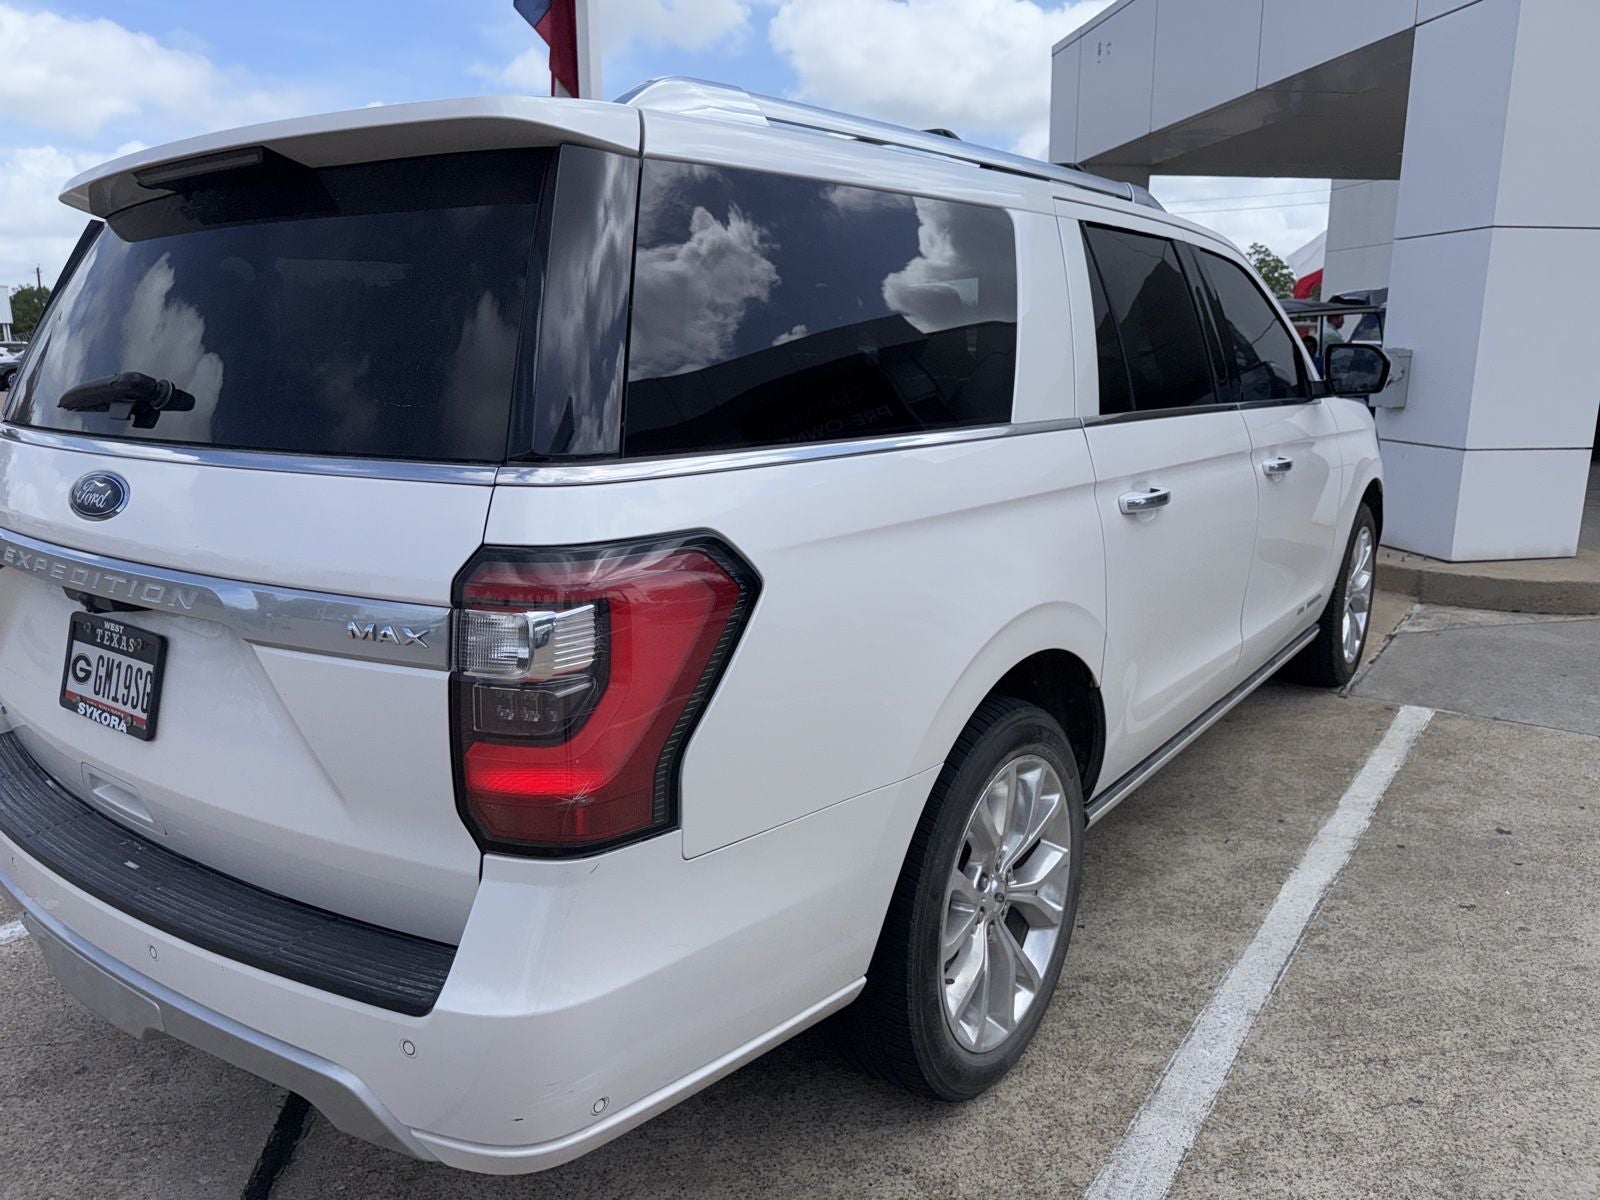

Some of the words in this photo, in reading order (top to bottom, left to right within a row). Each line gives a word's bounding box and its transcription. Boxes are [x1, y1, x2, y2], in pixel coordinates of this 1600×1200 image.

[76, 479, 112, 509] Ford
[2, 545, 198, 610] EXPEDITION
[95, 628, 135, 653] TEXAS
[104, 620, 125, 635] WEST
[346, 619, 431, 649] MAX
[77, 702, 127, 734] SYKORA
